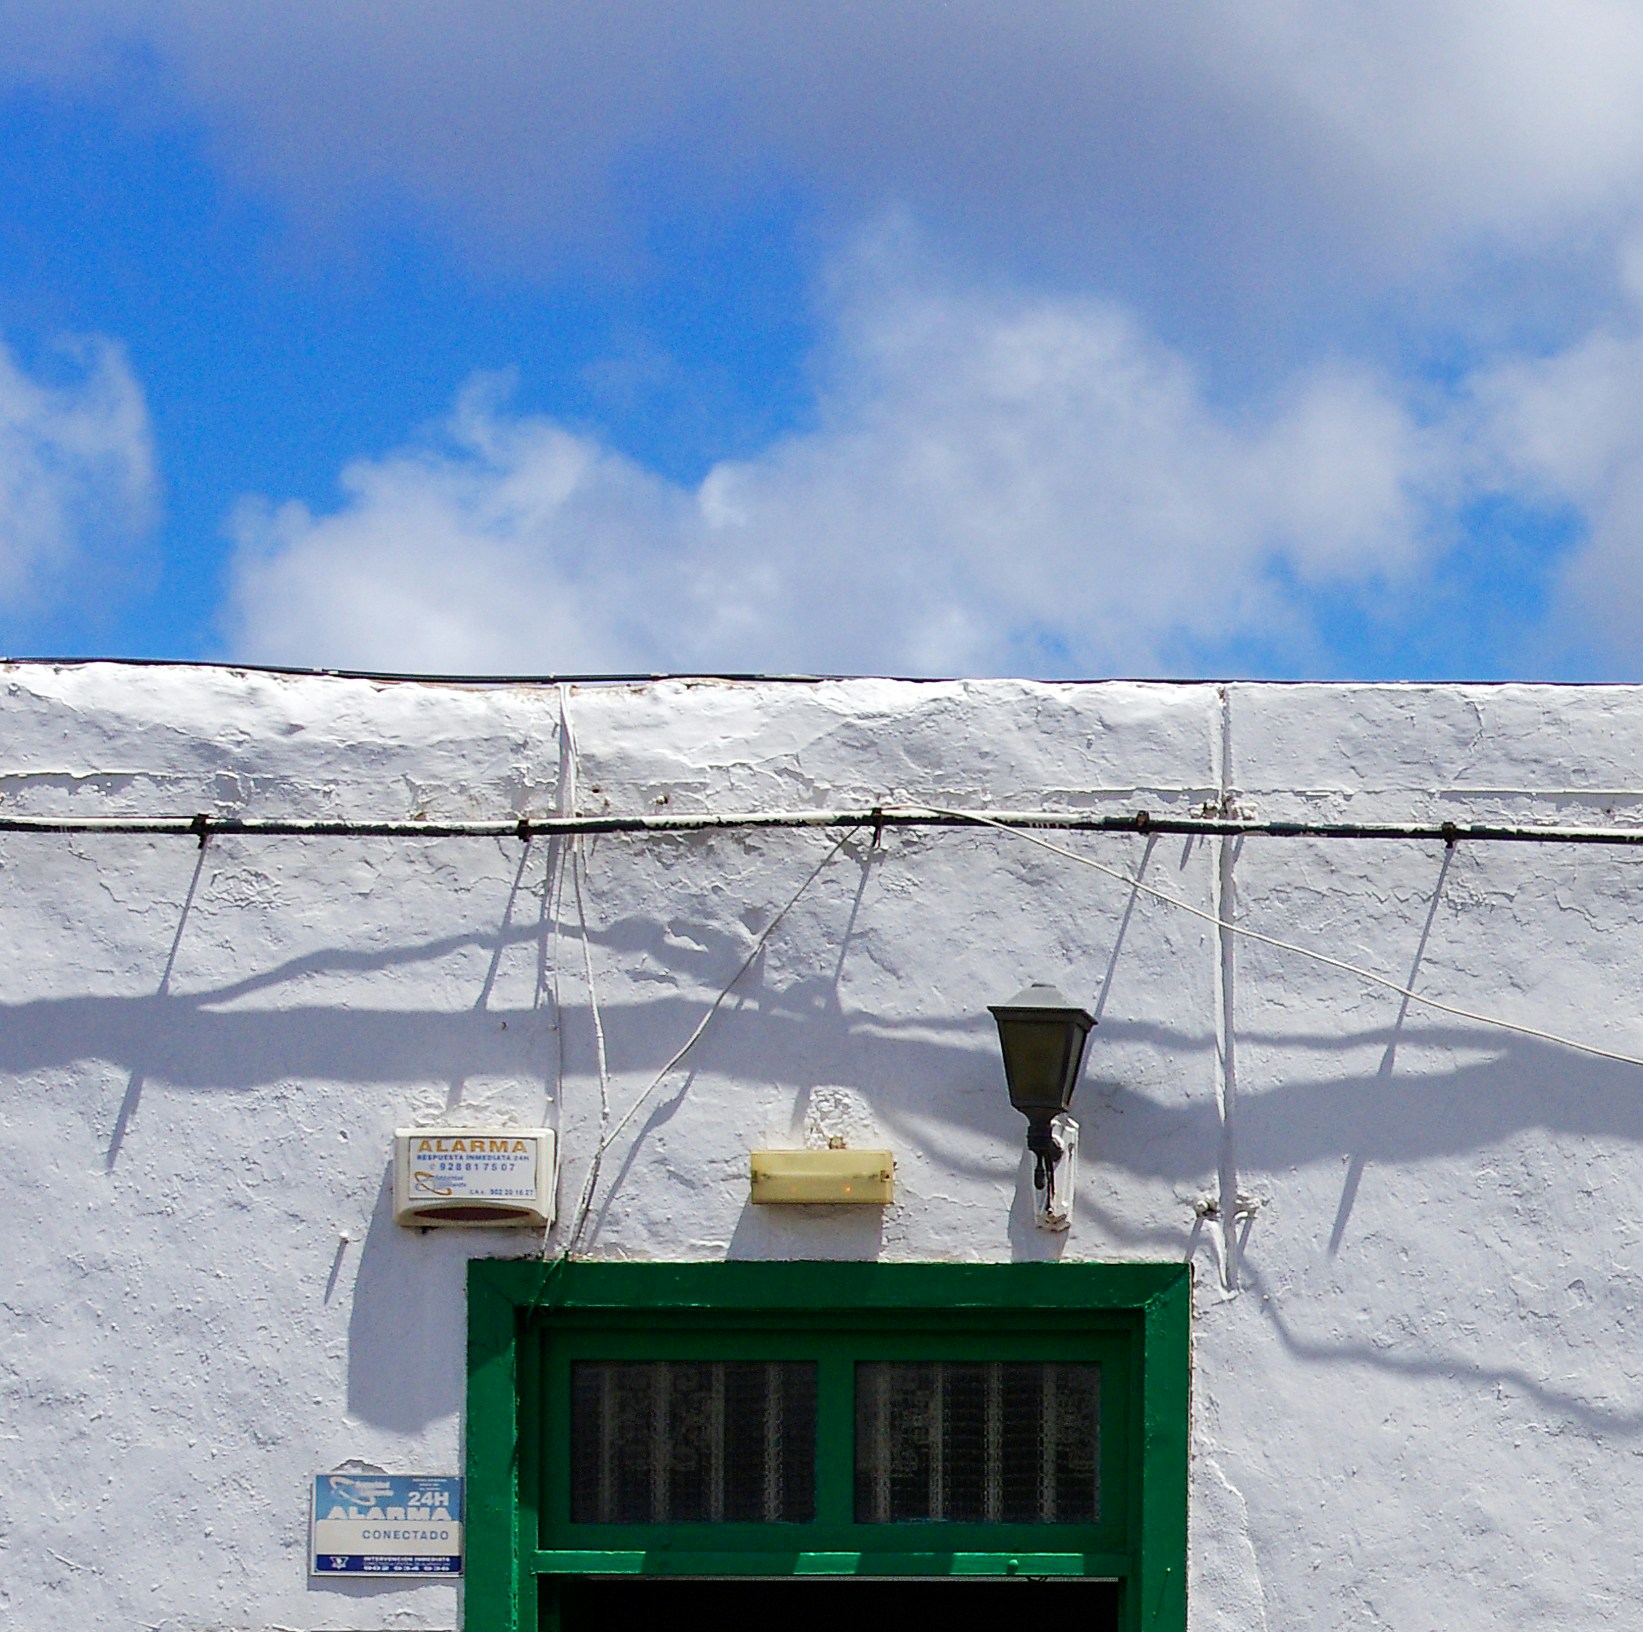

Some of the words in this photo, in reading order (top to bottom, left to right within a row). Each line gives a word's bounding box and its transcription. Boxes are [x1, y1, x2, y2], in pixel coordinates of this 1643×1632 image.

[418, 1139, 528, 1153] ALARMA
[408, 1491, 449, 1506] 24H
[327, 1505, 452, 1520] ALARMA
[362, 1529, 449, 1540] CONECTADO
